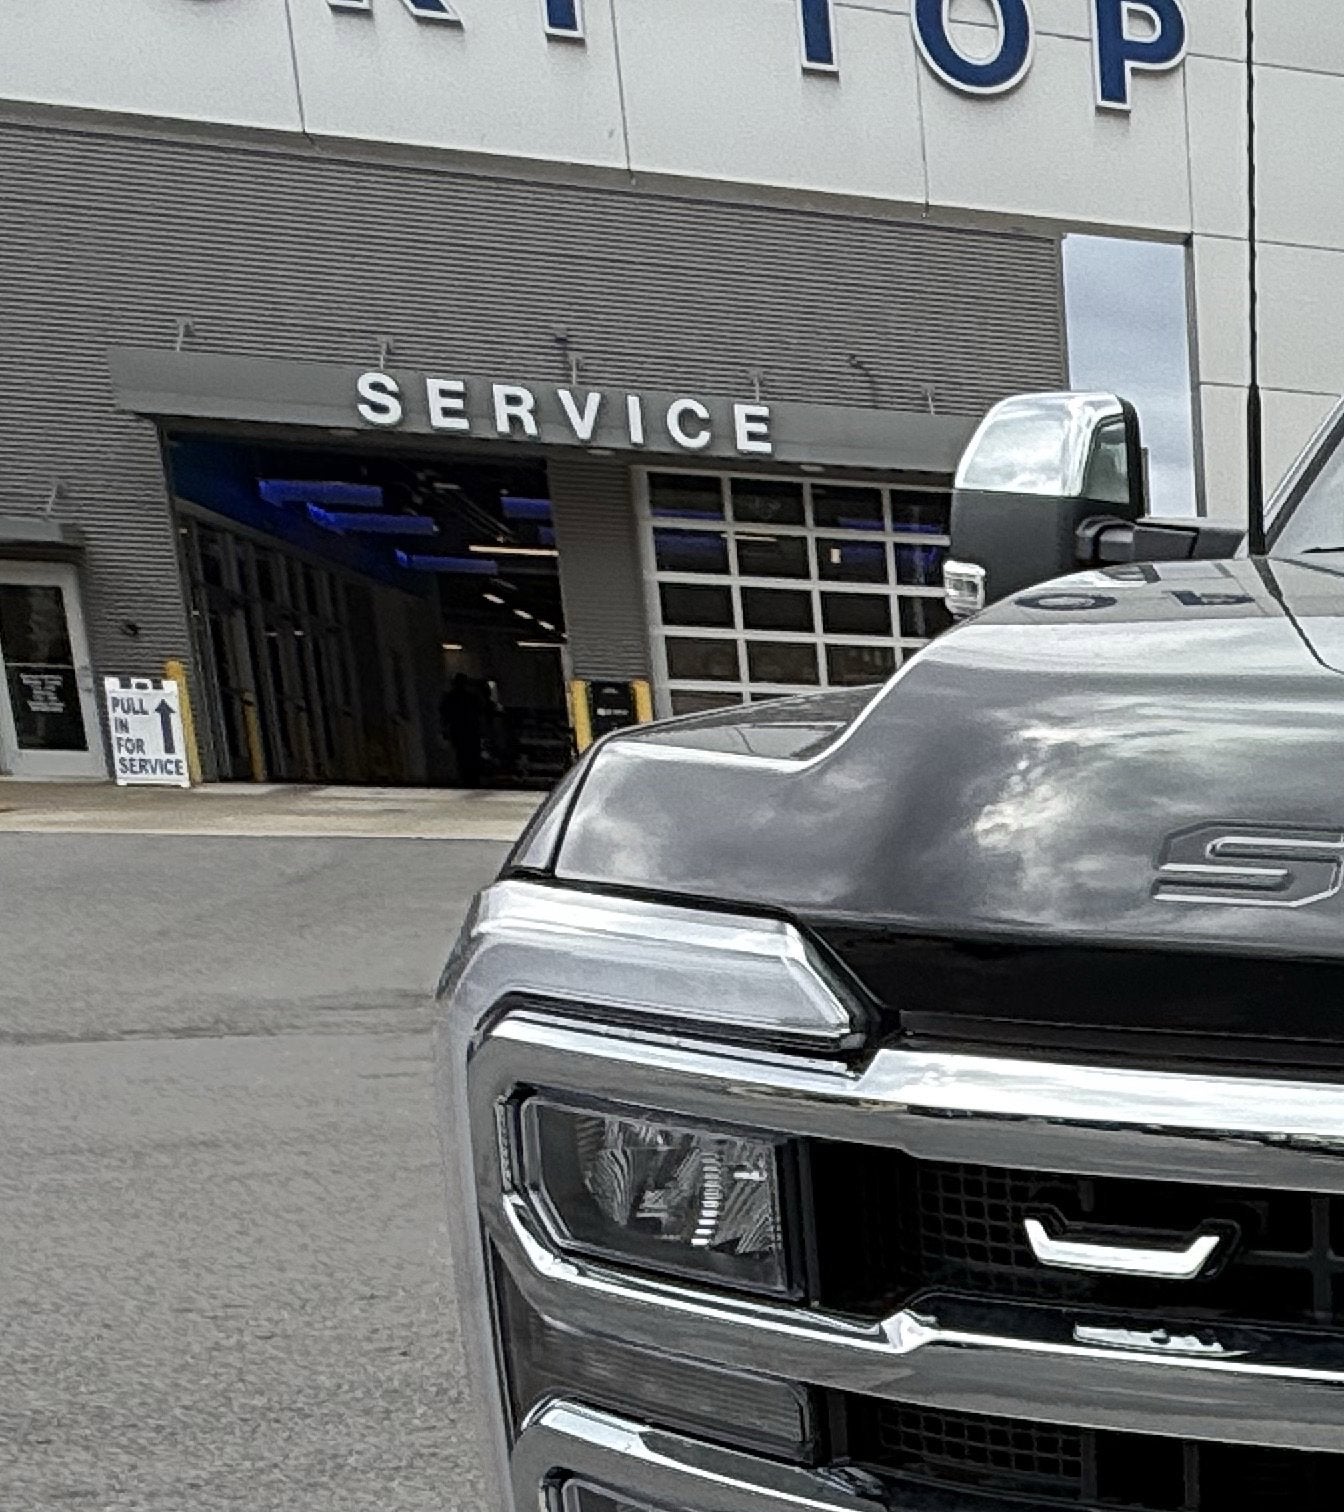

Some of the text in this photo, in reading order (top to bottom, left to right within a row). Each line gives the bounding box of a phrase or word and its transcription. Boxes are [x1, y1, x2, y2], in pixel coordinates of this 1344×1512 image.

[356, 371, 772, 454] SERVICE
[111, 696, 150, 716] PULL
[114, 716, 130, 734] IN
[116, 736, 146, 755] FOR
[119, 756, 185, 776] SERVICE
